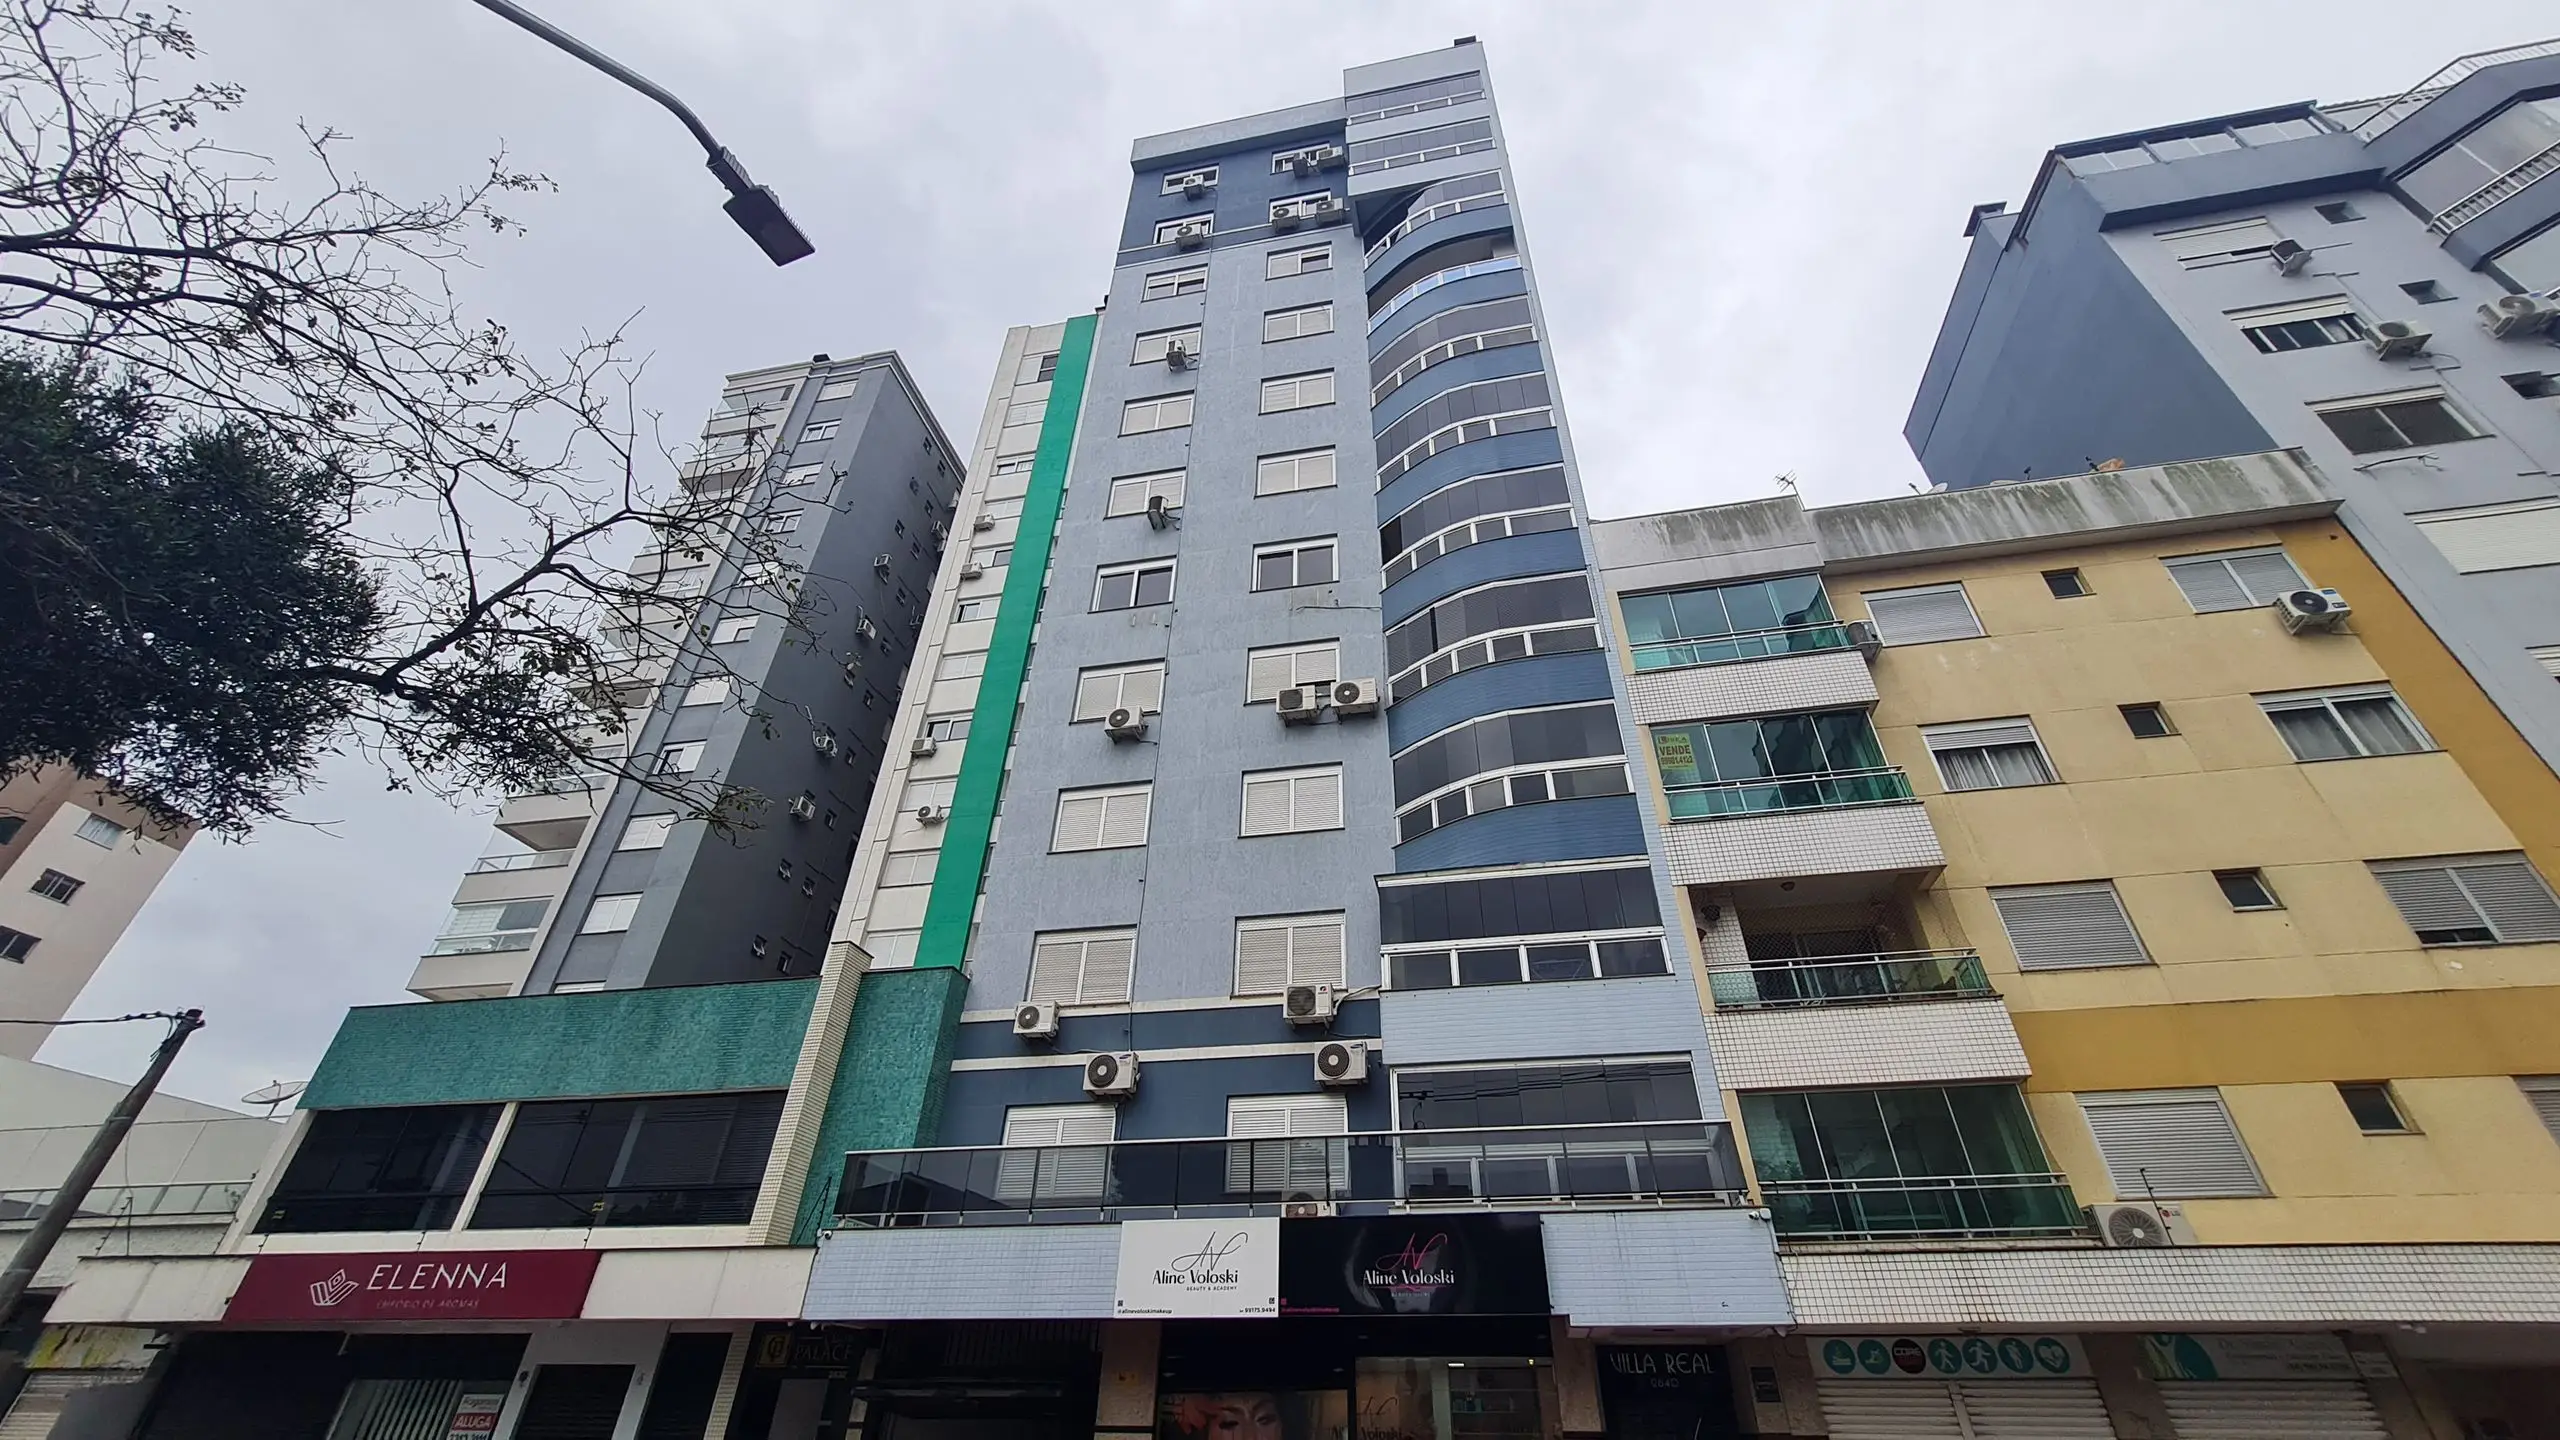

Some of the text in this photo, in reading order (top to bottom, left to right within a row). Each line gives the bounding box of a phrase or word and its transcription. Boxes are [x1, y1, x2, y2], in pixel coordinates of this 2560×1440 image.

[1659, 745, 1691, 756] VENDE
[366, 1262, 508, 1290] ELENNA
[1152, 1268, 1239, 1285] Aline Voloski
[1363, 1268, 1456, 1285] Aline Voloski
[1609, 1352, 1715, 1374] VILLA REAL
[454, 1415, 493, 1429] ALUGA
